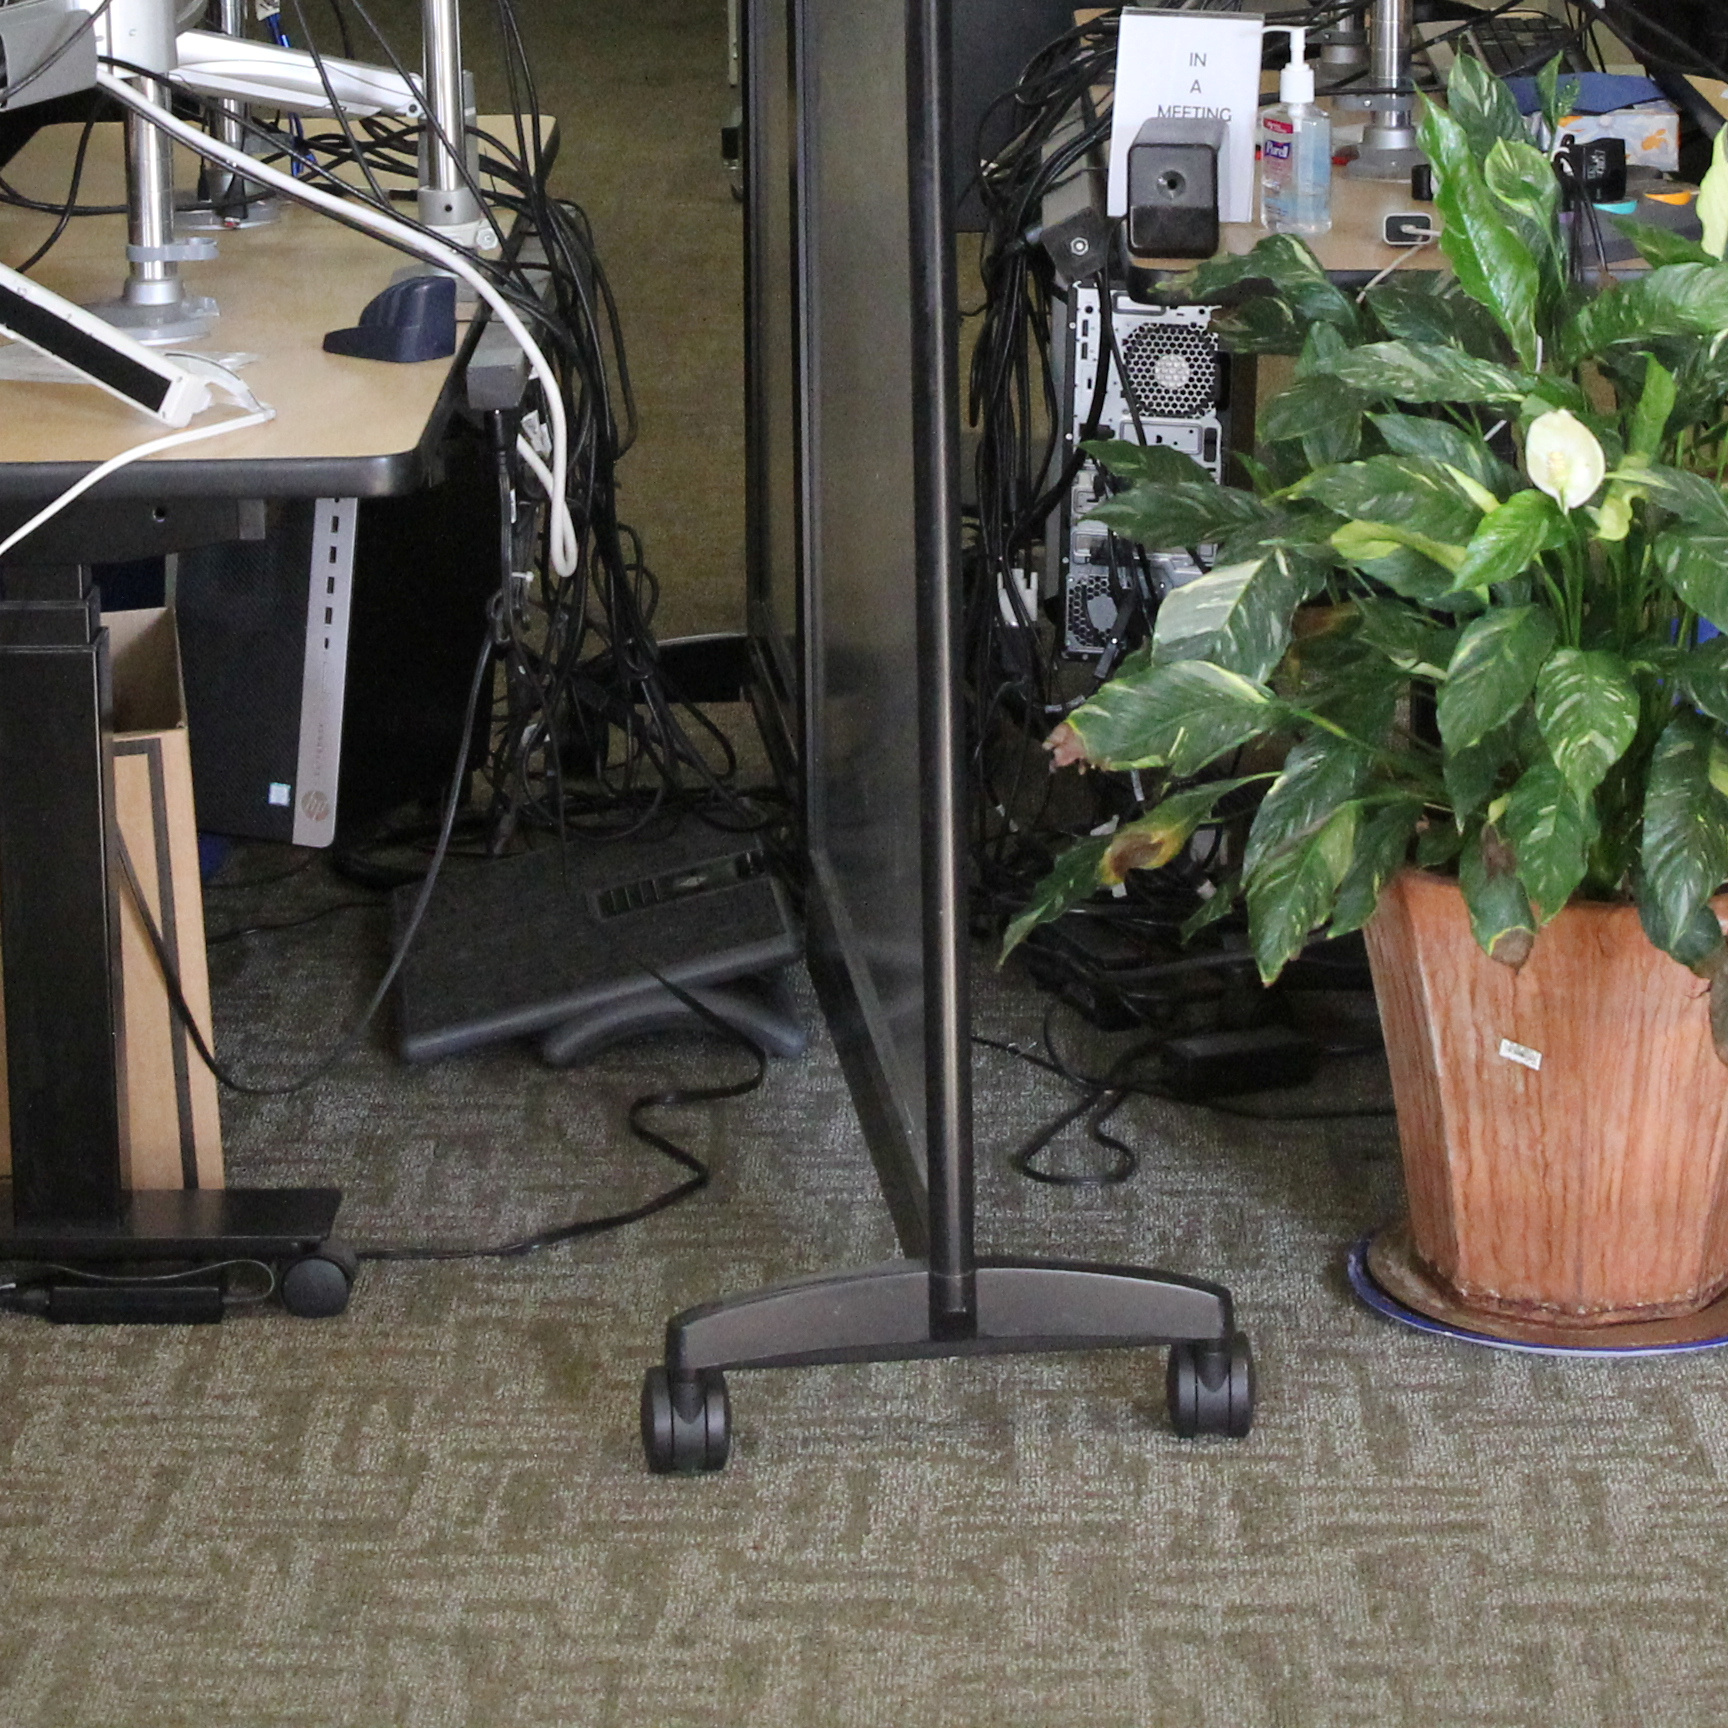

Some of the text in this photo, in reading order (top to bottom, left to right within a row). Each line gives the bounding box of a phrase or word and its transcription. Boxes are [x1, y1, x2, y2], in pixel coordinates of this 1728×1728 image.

[1189, 52, 1207, 67] IN
[1190, 79, 1202, 94] A
[1157, 105, 1232, 122] MEETING
